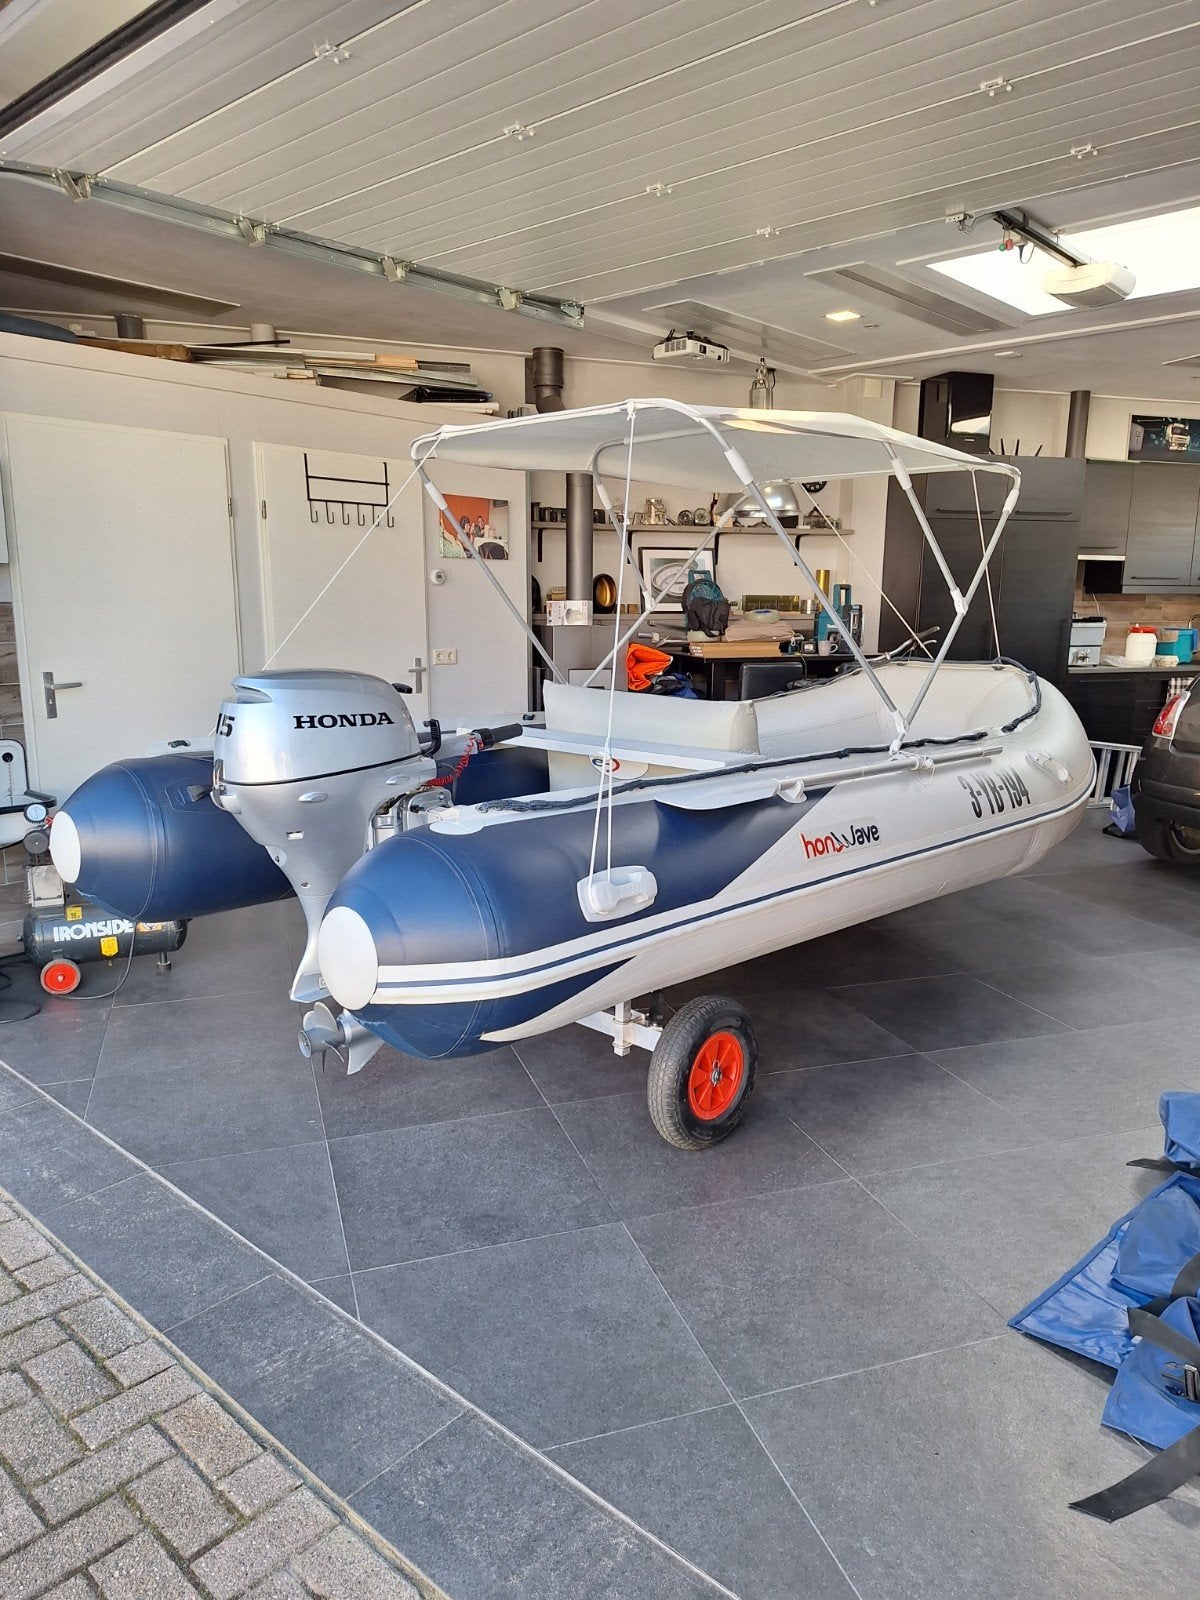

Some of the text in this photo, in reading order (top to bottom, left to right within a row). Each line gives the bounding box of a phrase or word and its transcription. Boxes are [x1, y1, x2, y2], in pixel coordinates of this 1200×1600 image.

[216, 713, 235, 737] 15
[293, 712, 395, 729] HONDA
[53, 919, 133, 942] IRONSIDE
